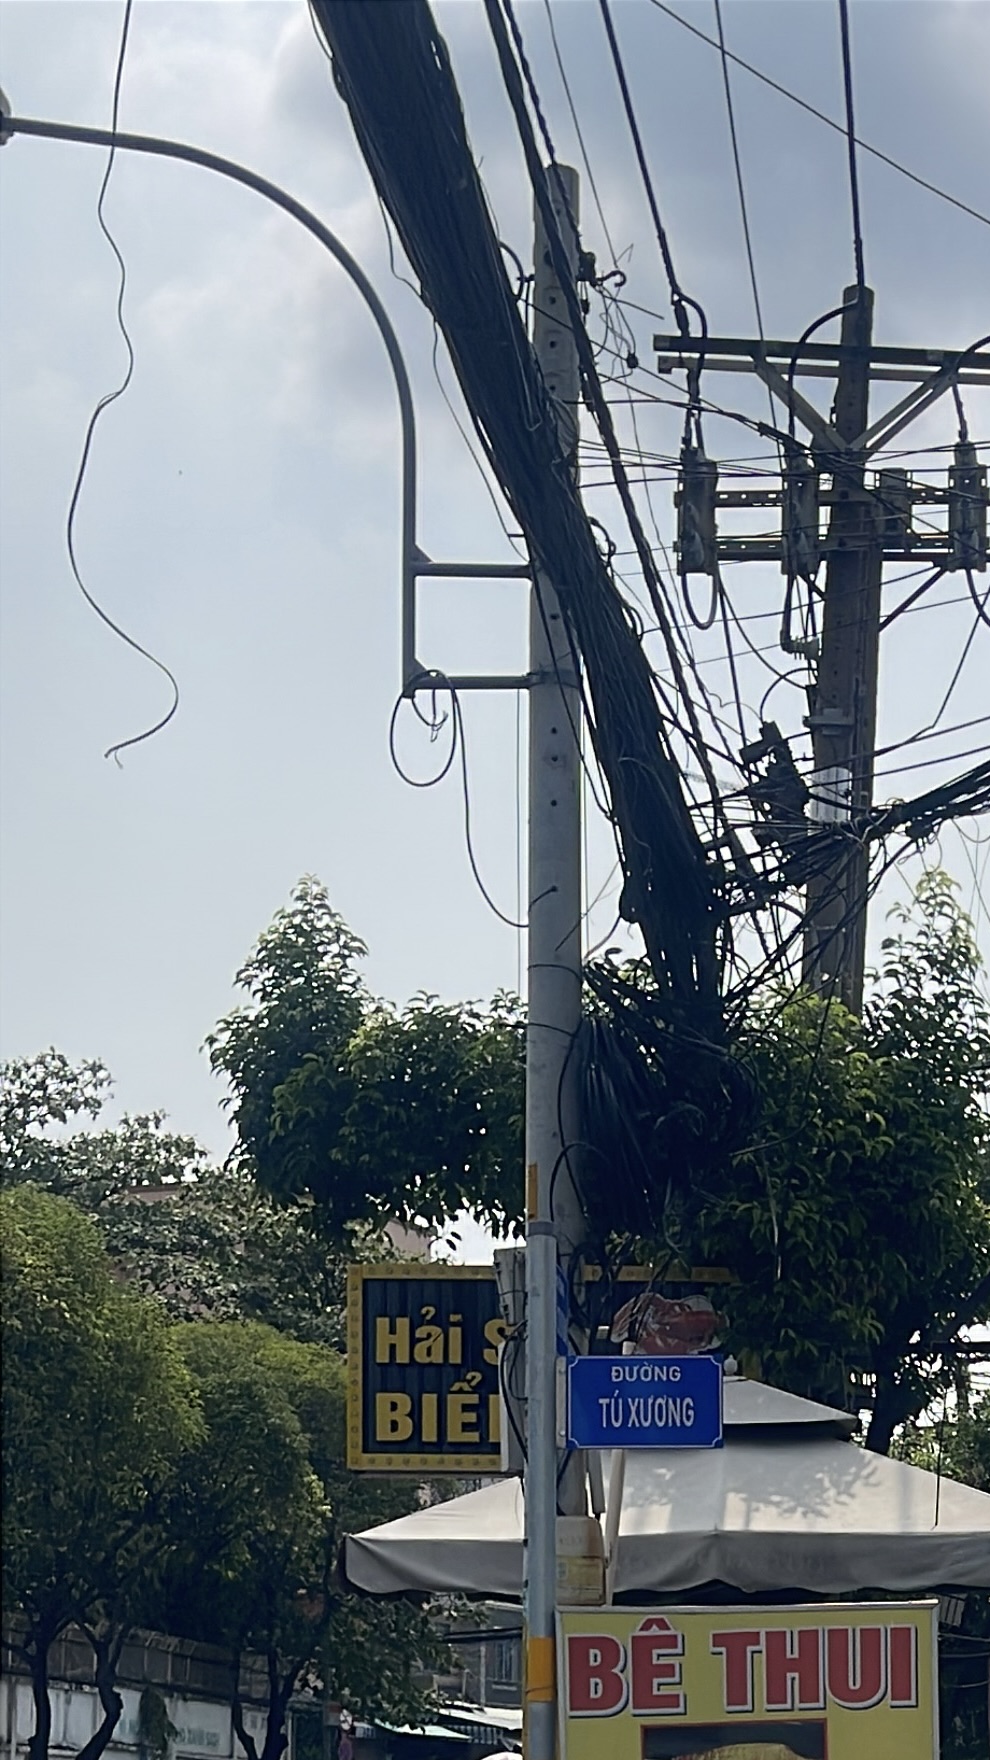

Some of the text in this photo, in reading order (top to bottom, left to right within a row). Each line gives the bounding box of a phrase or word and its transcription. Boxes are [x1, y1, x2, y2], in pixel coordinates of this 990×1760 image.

[376, 1306, 517, 1366] Hải S
[611, 1361, 681, 1382] ĐƯỜNG
[598, 1389, 695, 1428] TÚ XƯƠNG
[566, 1616, 918, 1718] BÊ THUI
